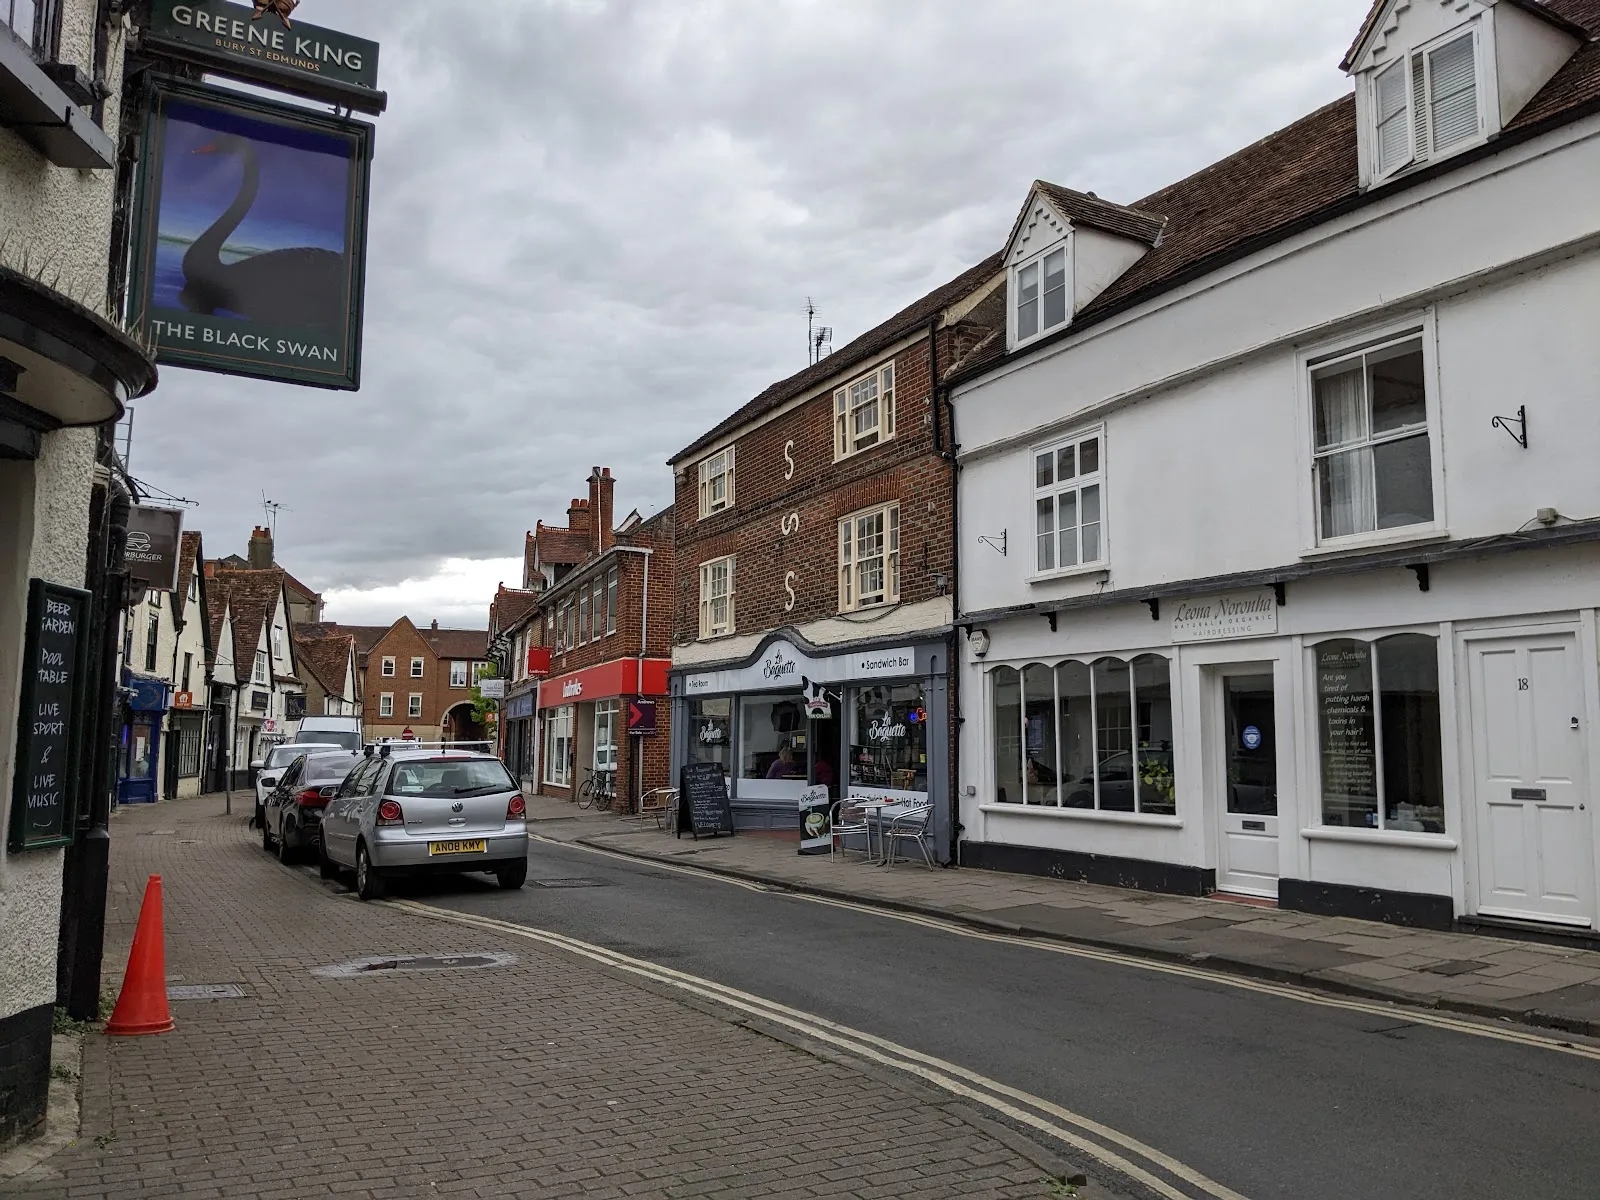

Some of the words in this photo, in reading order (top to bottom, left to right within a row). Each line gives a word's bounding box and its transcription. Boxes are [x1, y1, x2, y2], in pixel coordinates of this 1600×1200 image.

[172, 5, 284, 50] GREENE
[295, 37, 362, 70] KING
[215, 38, 246, 52] BURY
[250, 47, 262, 58] ST
[266, 52, 320, 72] EDMUNDS
[152, 320, 195, 340] THE
[202, 328, 270, 351] BLACK
[276, 340, 337, 362] SWAN
[46, 598, 71, 616] BEER
[1174, 603, 1211, 622] Leona
[1214, 594, 1272, 620] Noronha
[1174, 620, 1214, 629] NATURAL
[1228, 614, 1272, 624] ORGANIC
[1193, 626, 1252, 636] HAIRDRESSING
[42, 648, 64, 666] POOL
[774, 649, 782, 664] La
[866, 657, 896, 670] Sandwich
[898, 656, 909, 667] Bar
[38, 668, 68, 684] TABLE
[764, 660, 796, 680] Baguette
[698, 680, 708, 688] Room
[1335, 674, 1347, 682] you
[1518, 678, 1528, 690] 18
[1324, 684, 1338, 692] tired
[1325, 695, 1350, 704] putting
[1350, 694, 1370, 702] harsh
[38, 703, 60, 716] LIVE
[1326, 706, 1359, 714] chemicals
[882, 711, 892, 726] La
[34, 720, 64, 735] SPORT
[700, 726, 722, 744] Baguette
[868, 720, 906, 742] Baguette
[1330, 729, 1344, 738] your
[1346, 728, 1364, 736] hair?
[40, 746, 52, 764] &
[34, 774, 56, 789] LIVE
[28, 792, 60, 808] MUSIC
[901, 798, 911, 807] Hot
[436, 842, 460, 852] AN08
[462, 841, 480, 850] KMY
